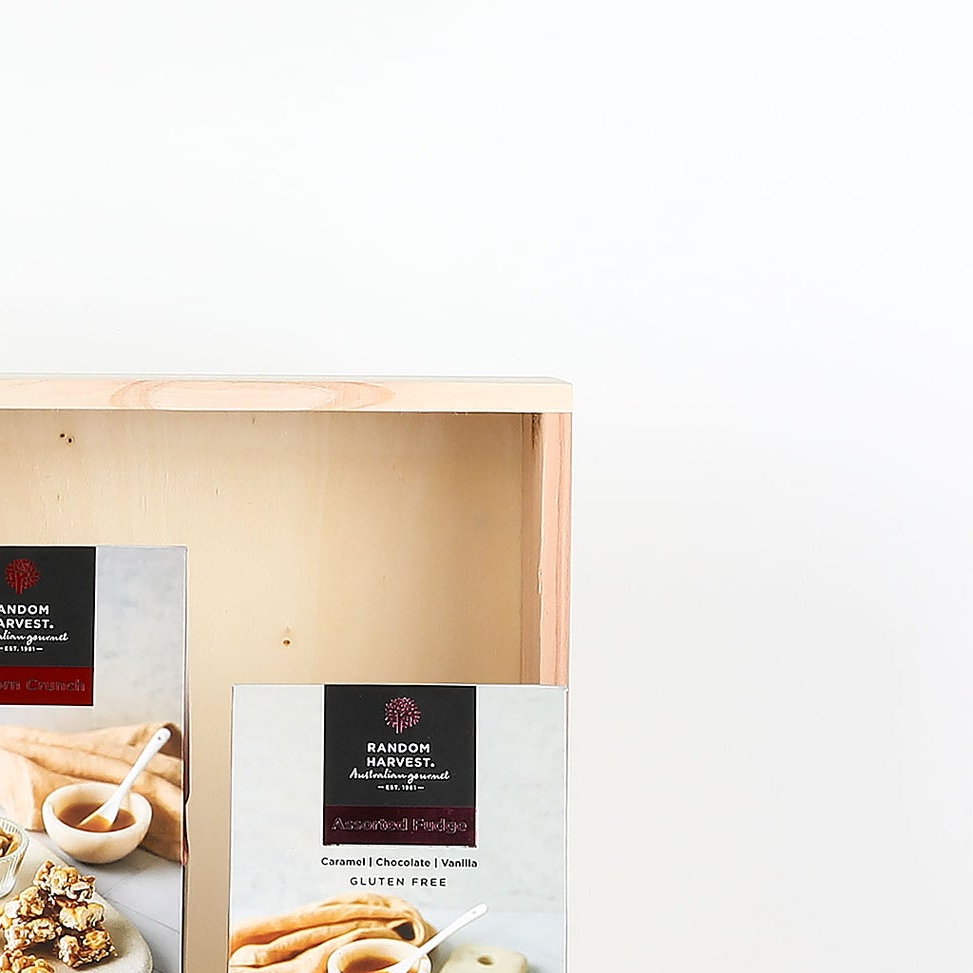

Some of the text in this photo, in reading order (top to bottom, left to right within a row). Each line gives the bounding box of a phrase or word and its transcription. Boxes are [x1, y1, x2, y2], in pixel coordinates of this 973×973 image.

[25, 632, 69, 645] gourmet
[26, 679, 86, 692] Crunch
[366, 742, 430, 753] RANDOM
[348, 768, 451, 784] Australian gourmet
[330, 817, 468, 834] Assorted Fudge
[321, 856, 478, 868] Caramel Chocolate Vanilla
[349, 876, 447, 887] GLUTEN FREE
